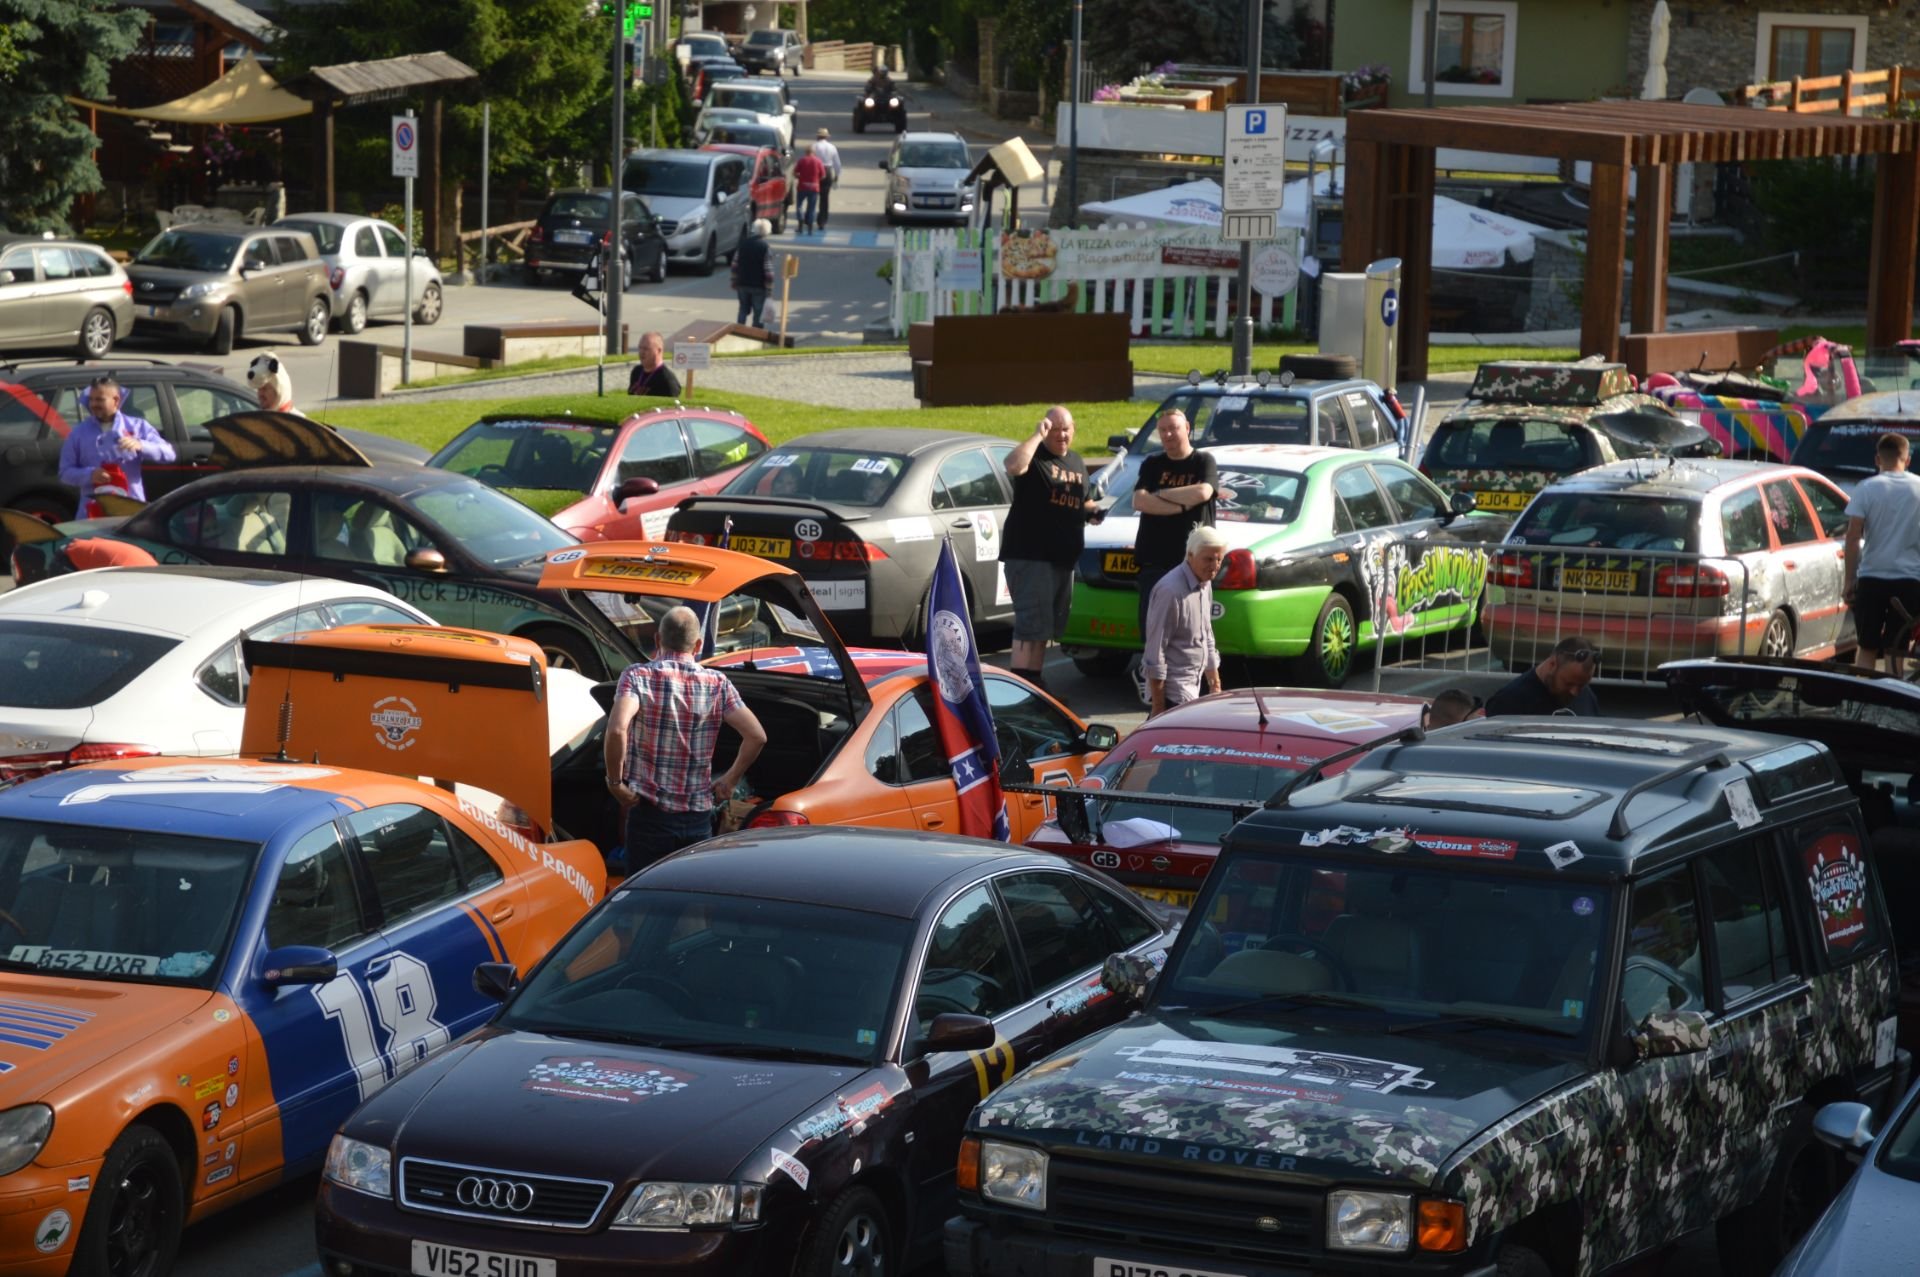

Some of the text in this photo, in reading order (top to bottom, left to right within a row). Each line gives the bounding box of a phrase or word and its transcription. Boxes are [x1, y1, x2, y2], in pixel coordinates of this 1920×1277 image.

[1249, 113, 1262, 132] P
[1078, 238, 1111, 249] PIZZA
[1384, 298, 1397, 317] P
[1052, 466, 1083, 484] FART
[1051, 492, 1081, 509] LOUD
[798, 524, 819, 537] GB
[726, 539, 785, 555] J03 ZWT
[553, 551, 580, 563] GB
[838, 585, 865, 599] signs
[1224, 748, 1292, 761] Barcelona
[1093, 852, 1119, 867] GB
[542, 850, 595, 907] RACING
[93, 954, 147, 975] UXR
[310, 950, 450, 1103] 18
[1210, 1080, 1298, 1097] Barcelona
[1076, 1130, 1298, 1171] LAND ROVER
[426, 1246, 480, 1277] V152
